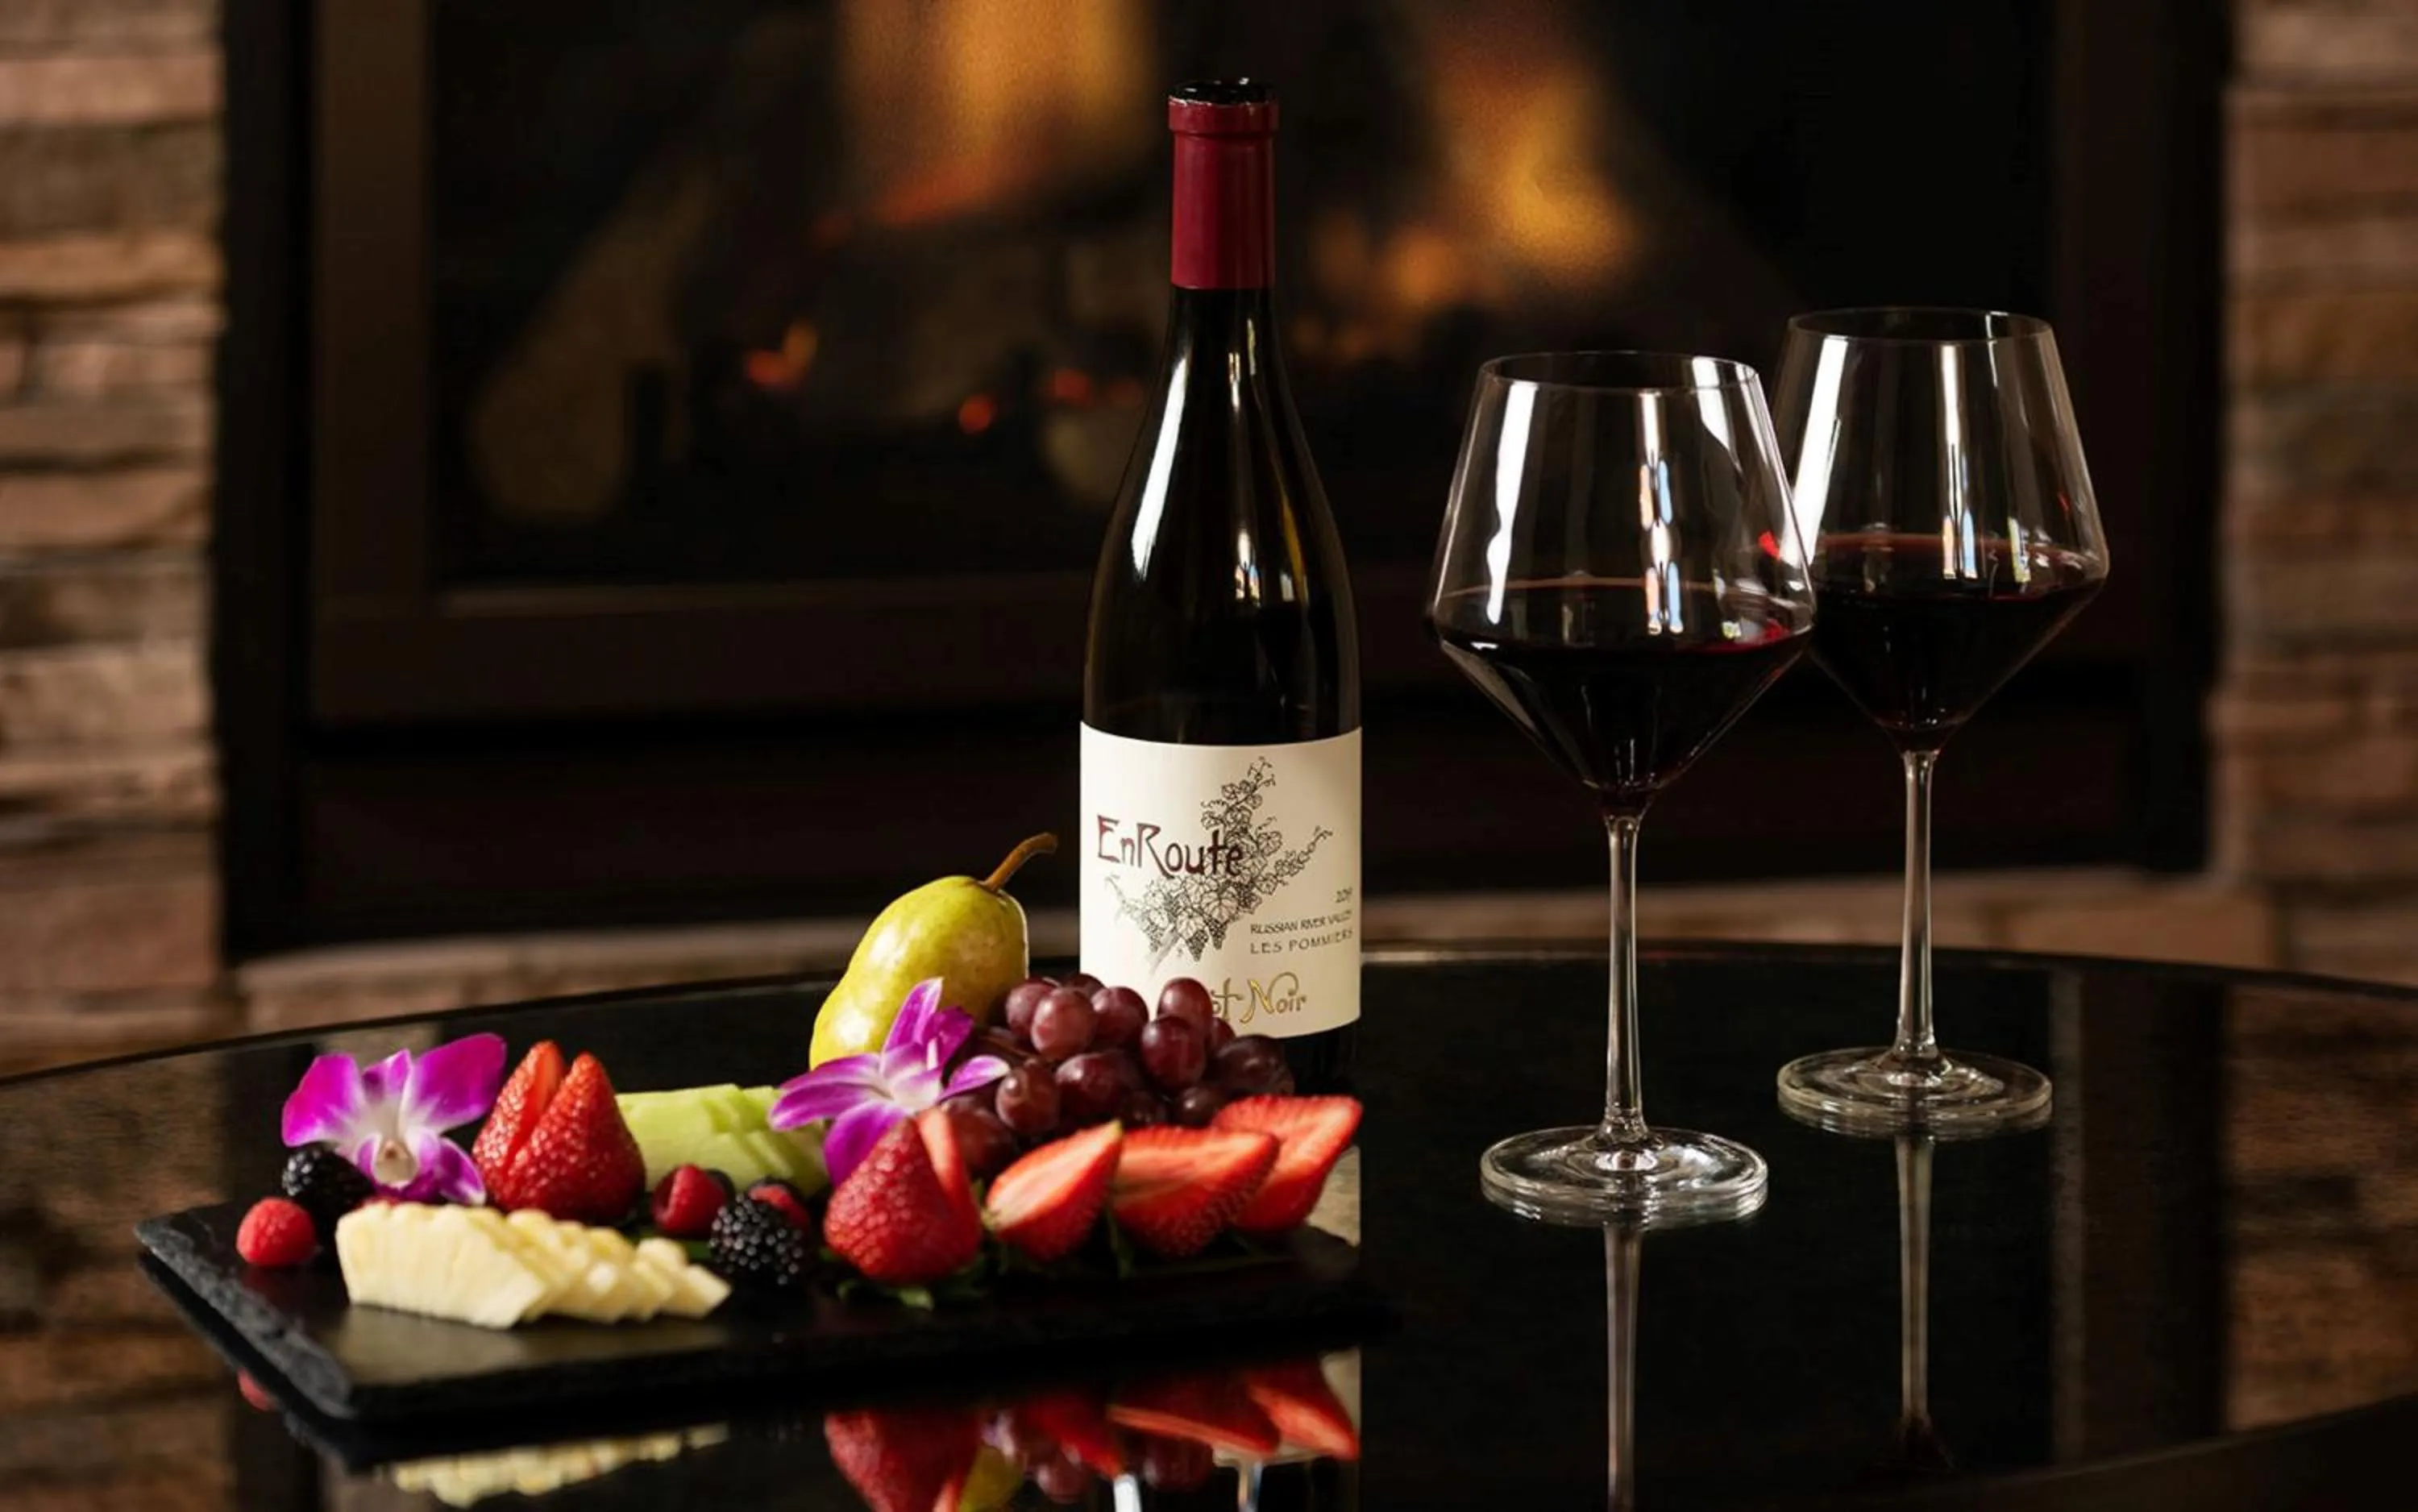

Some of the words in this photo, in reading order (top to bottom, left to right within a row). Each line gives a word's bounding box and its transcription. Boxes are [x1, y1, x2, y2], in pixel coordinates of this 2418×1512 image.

[1097, 814, 1243, 879] EnRoute
[1250, 920, 1298, 934] RUSSIAN
[1300, 916, 1326, 930] RIVER
[1250, 941, 1282, 954] LES
[1239, 971, 1307, 1024] Noir
